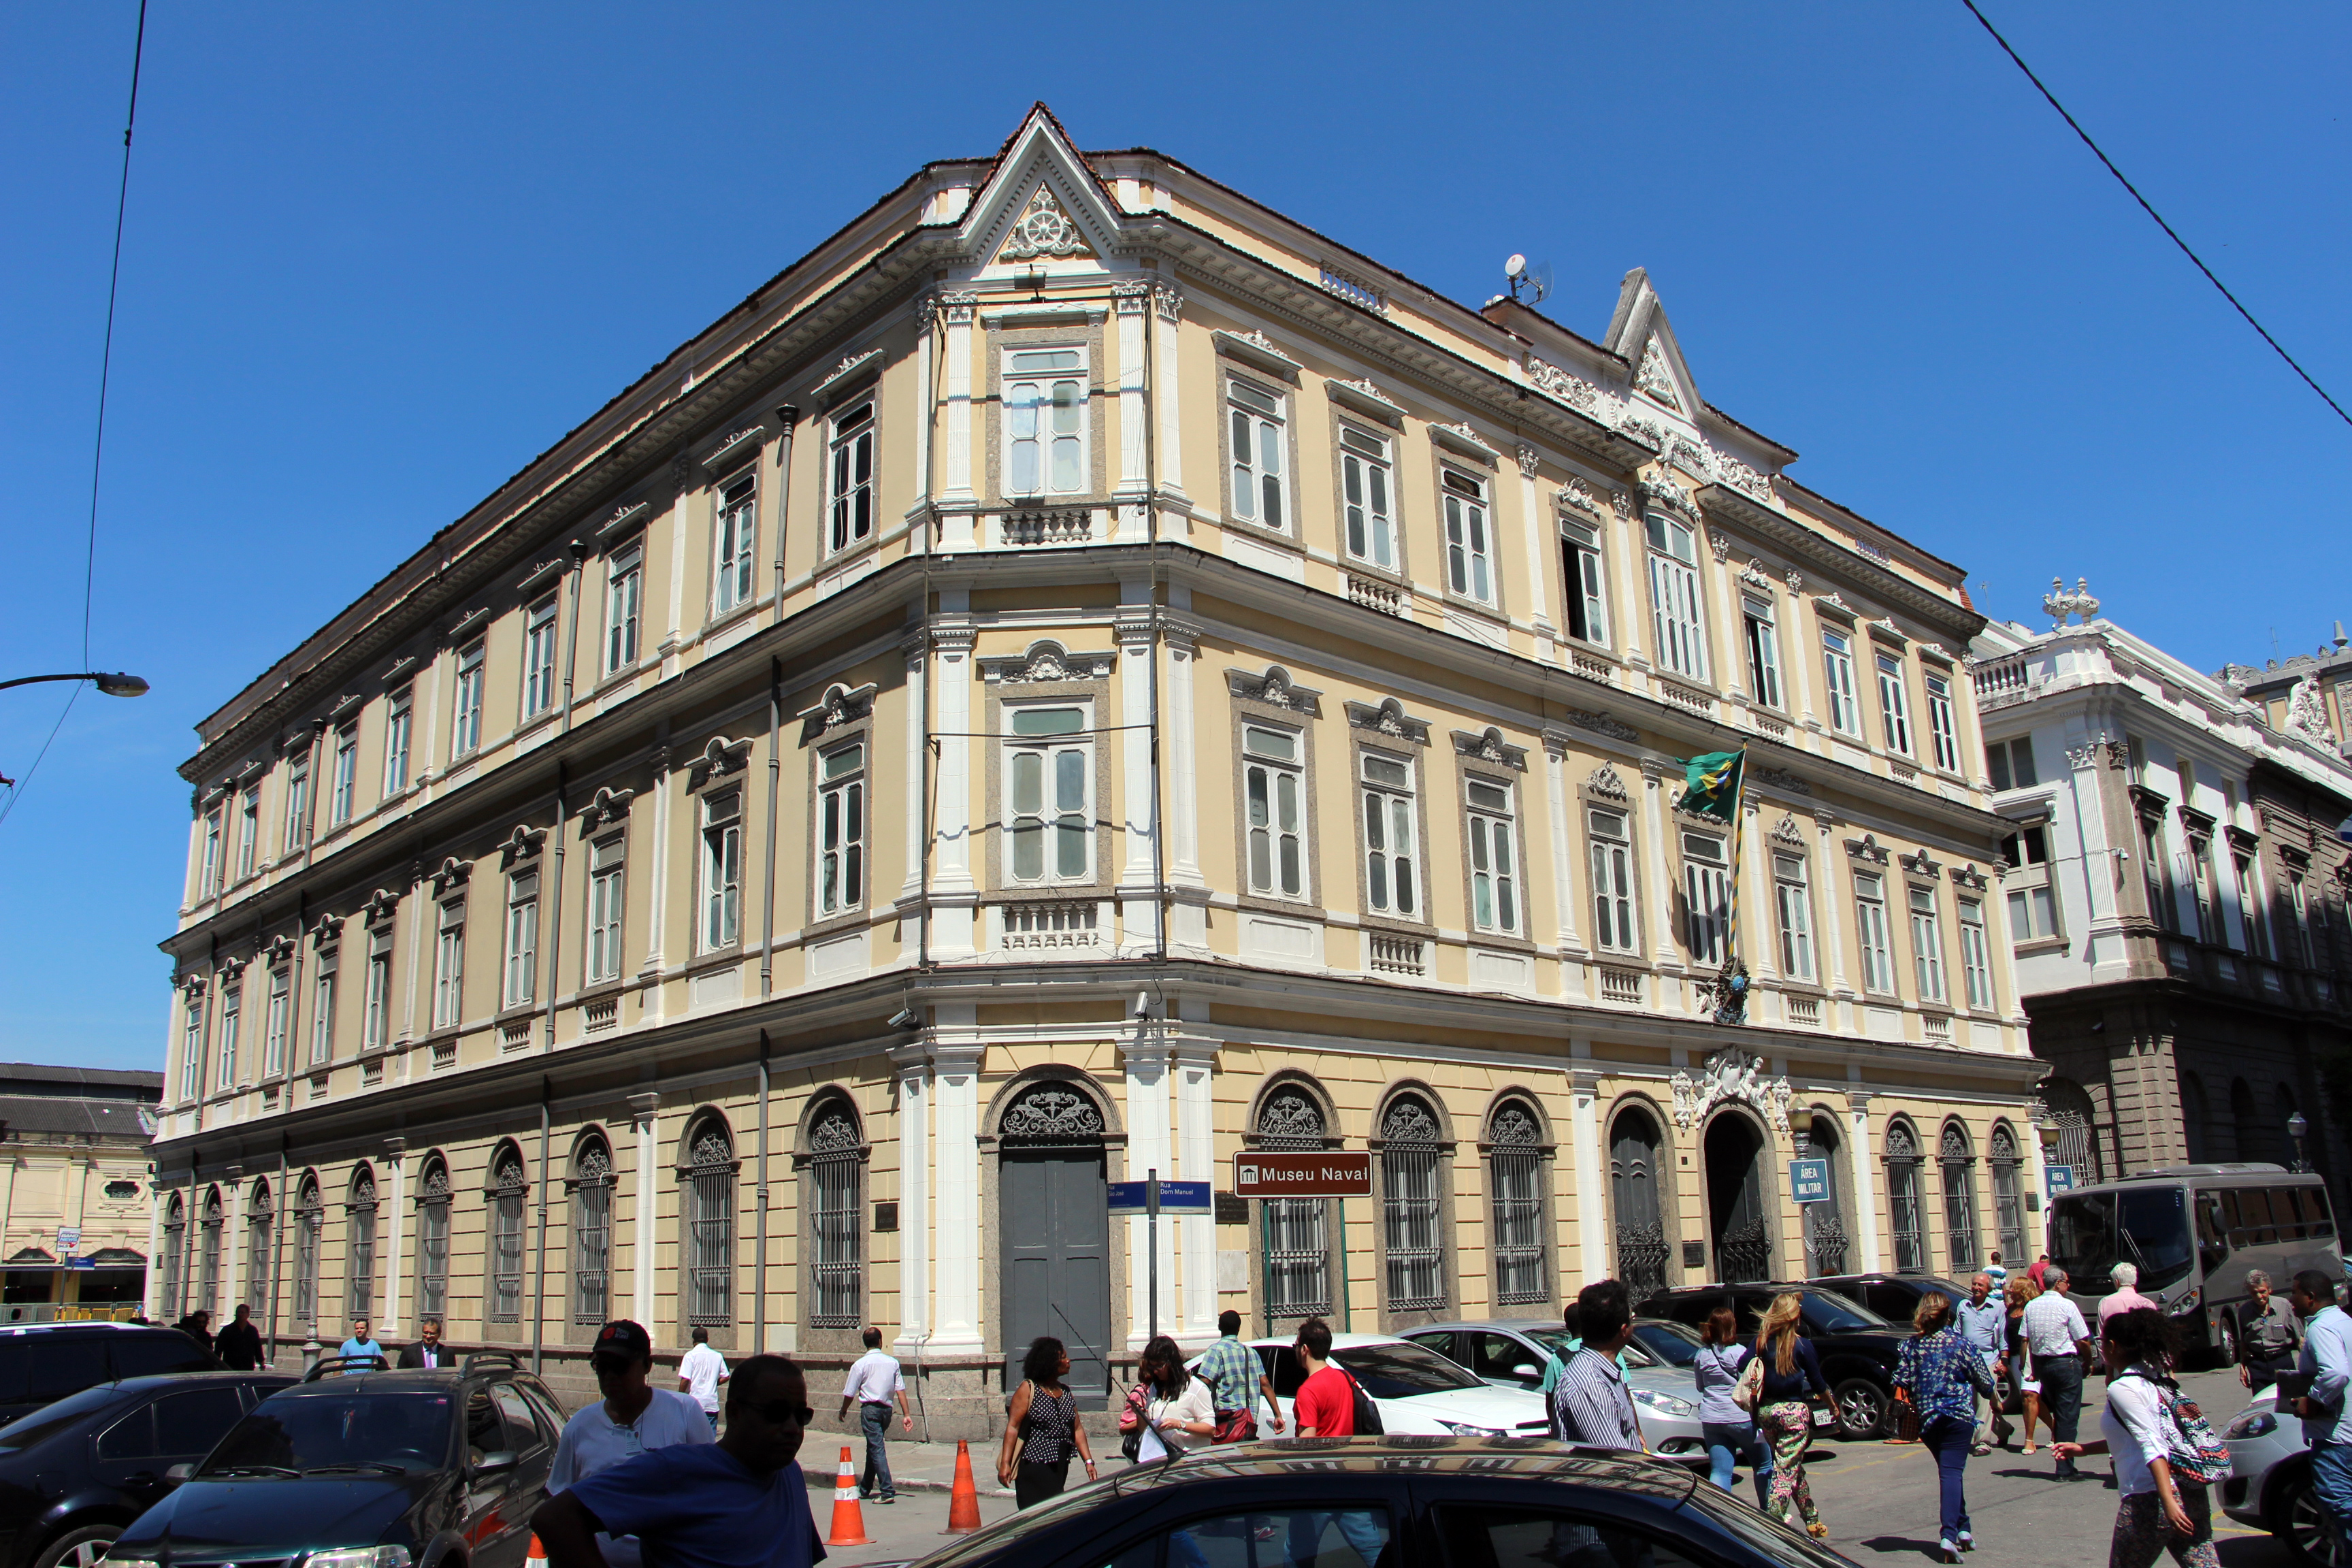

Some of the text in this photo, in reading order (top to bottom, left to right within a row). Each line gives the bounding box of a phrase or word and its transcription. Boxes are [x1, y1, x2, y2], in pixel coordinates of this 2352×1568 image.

[1262, 1166, 1368, 1181] Museu Naval
[1801, 1164, 1818, 1179] ÁREA
[2051, 1169, 2065, 1181] ÁREA
[1797, 1182, 1822, 1194] MILITAR
